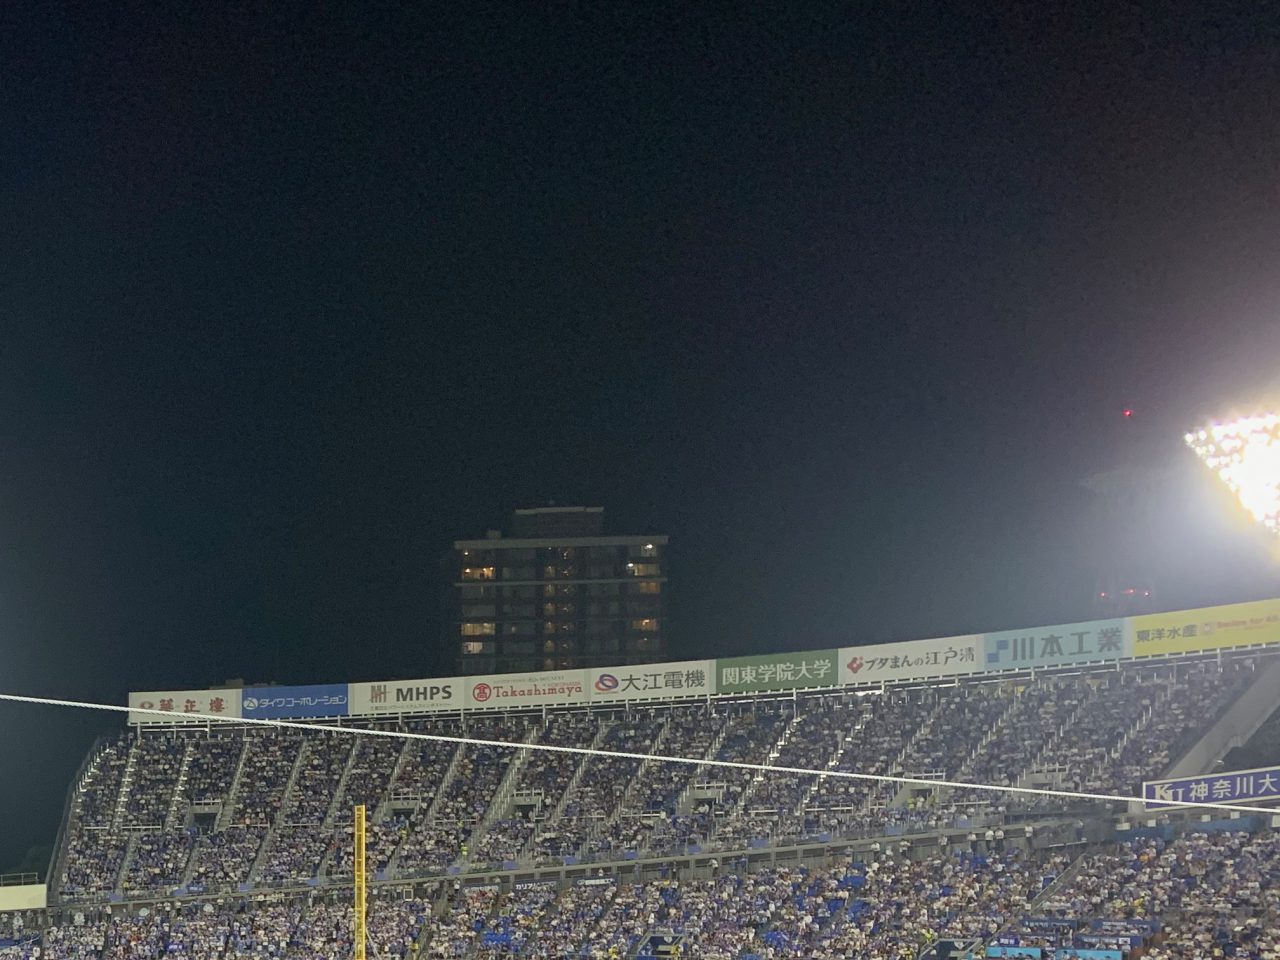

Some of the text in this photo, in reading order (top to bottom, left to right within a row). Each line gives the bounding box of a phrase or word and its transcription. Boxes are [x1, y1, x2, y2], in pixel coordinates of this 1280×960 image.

[1012, 628, 1122, 661] 川本工業
[621, 669, 705, 692] 大江電機
[723, 658, 831, 685] 関東学院大学
[396, 685, 452, 702] MHPS
[493, 684, 583, 698] Takashimaya
[259, 696, 347, 709] ダイワコーポレーション
